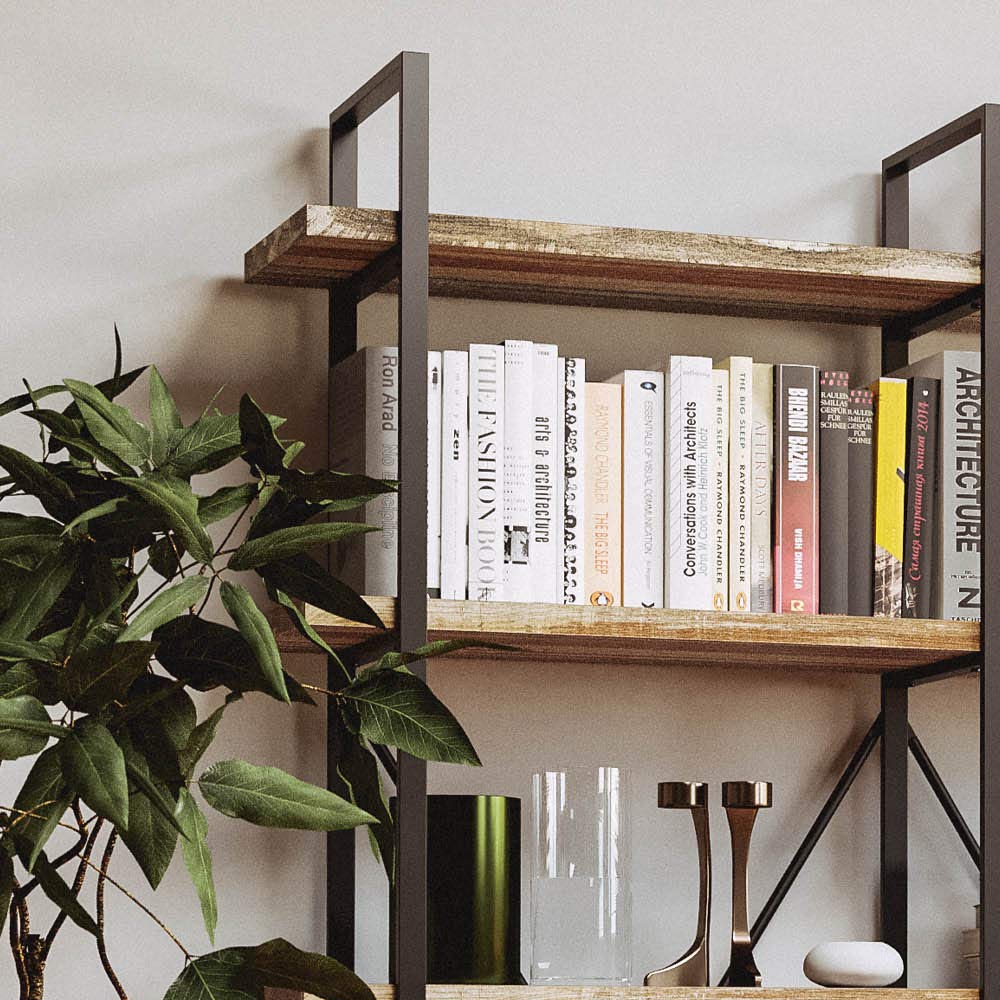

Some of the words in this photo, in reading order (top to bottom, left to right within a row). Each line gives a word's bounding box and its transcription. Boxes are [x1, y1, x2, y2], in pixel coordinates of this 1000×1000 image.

[382, 355, 397, 387] Ron
[478, 352, 496, 401] THE
[382, 392, 397, 431] Arad
[535, 417, 551, 441] arts
[684, 401, 696, 458] Architects
[788, 388, 808, 432] BHENDI
[382, 444, 394, 465] No
[478, 411, 496, 520] FASHION
[684, 461, 696, 490] with
[788, 436, 808, 481] BAZAAR
[955, 367, 981, 552] ARCHITECTURE
[535, 465, 552, 543] architecture
[684, 493, 696, 576] Conversations
